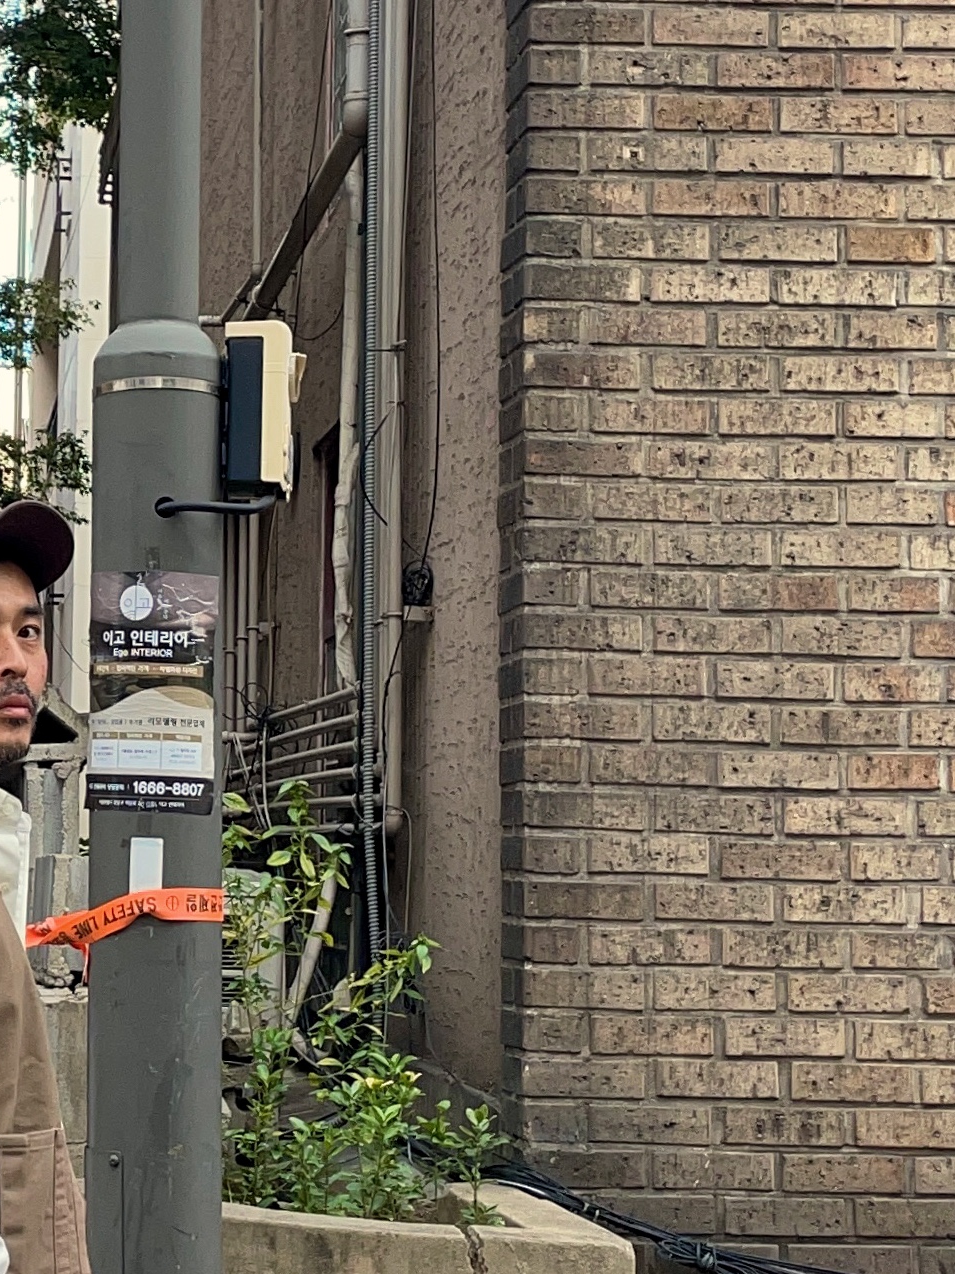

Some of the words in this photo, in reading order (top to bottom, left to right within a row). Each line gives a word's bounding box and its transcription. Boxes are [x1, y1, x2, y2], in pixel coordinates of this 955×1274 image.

[103, 630, 125, 646] 이고
[130, 630, 188, 648] 인테리어
[113, 648, 129, 658] Ego
[131, 648, 173, 658] INTERIOR
[132, 781, 205, 797] 1666-8807
[103, 897, 157, 925] SAFETY
[72, 915, 98, 939] LINE
